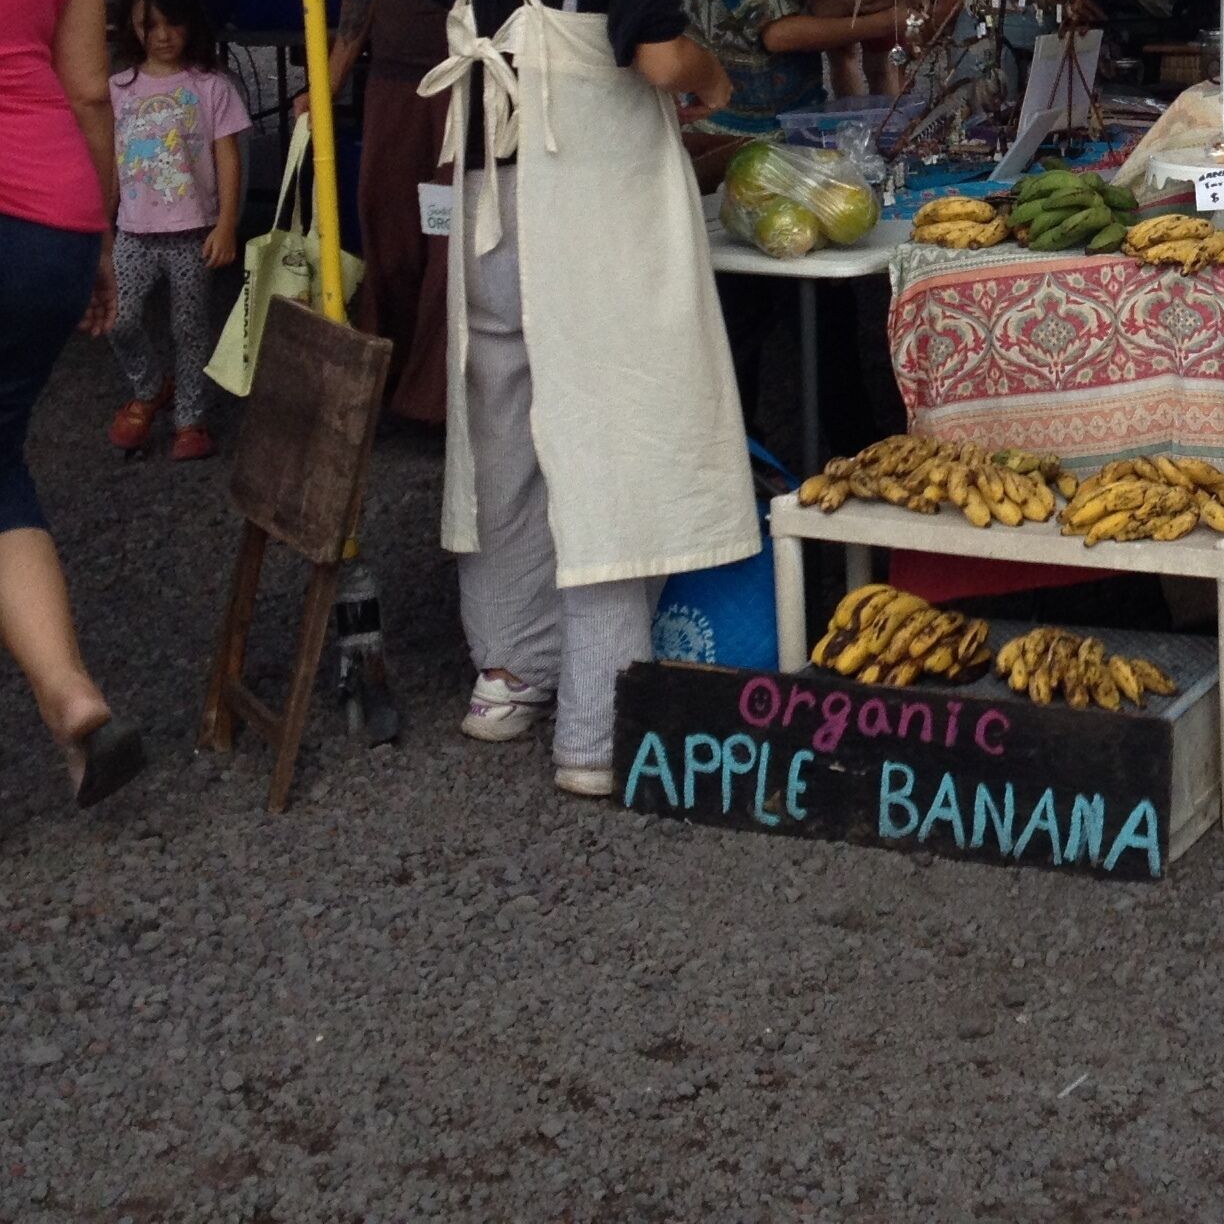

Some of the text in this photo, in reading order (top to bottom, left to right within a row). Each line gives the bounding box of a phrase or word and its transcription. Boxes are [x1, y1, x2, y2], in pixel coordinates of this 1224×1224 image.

[739, 677, 1011, 755] Organic
[623, 730, 1162, 878] APPLE BANANA
